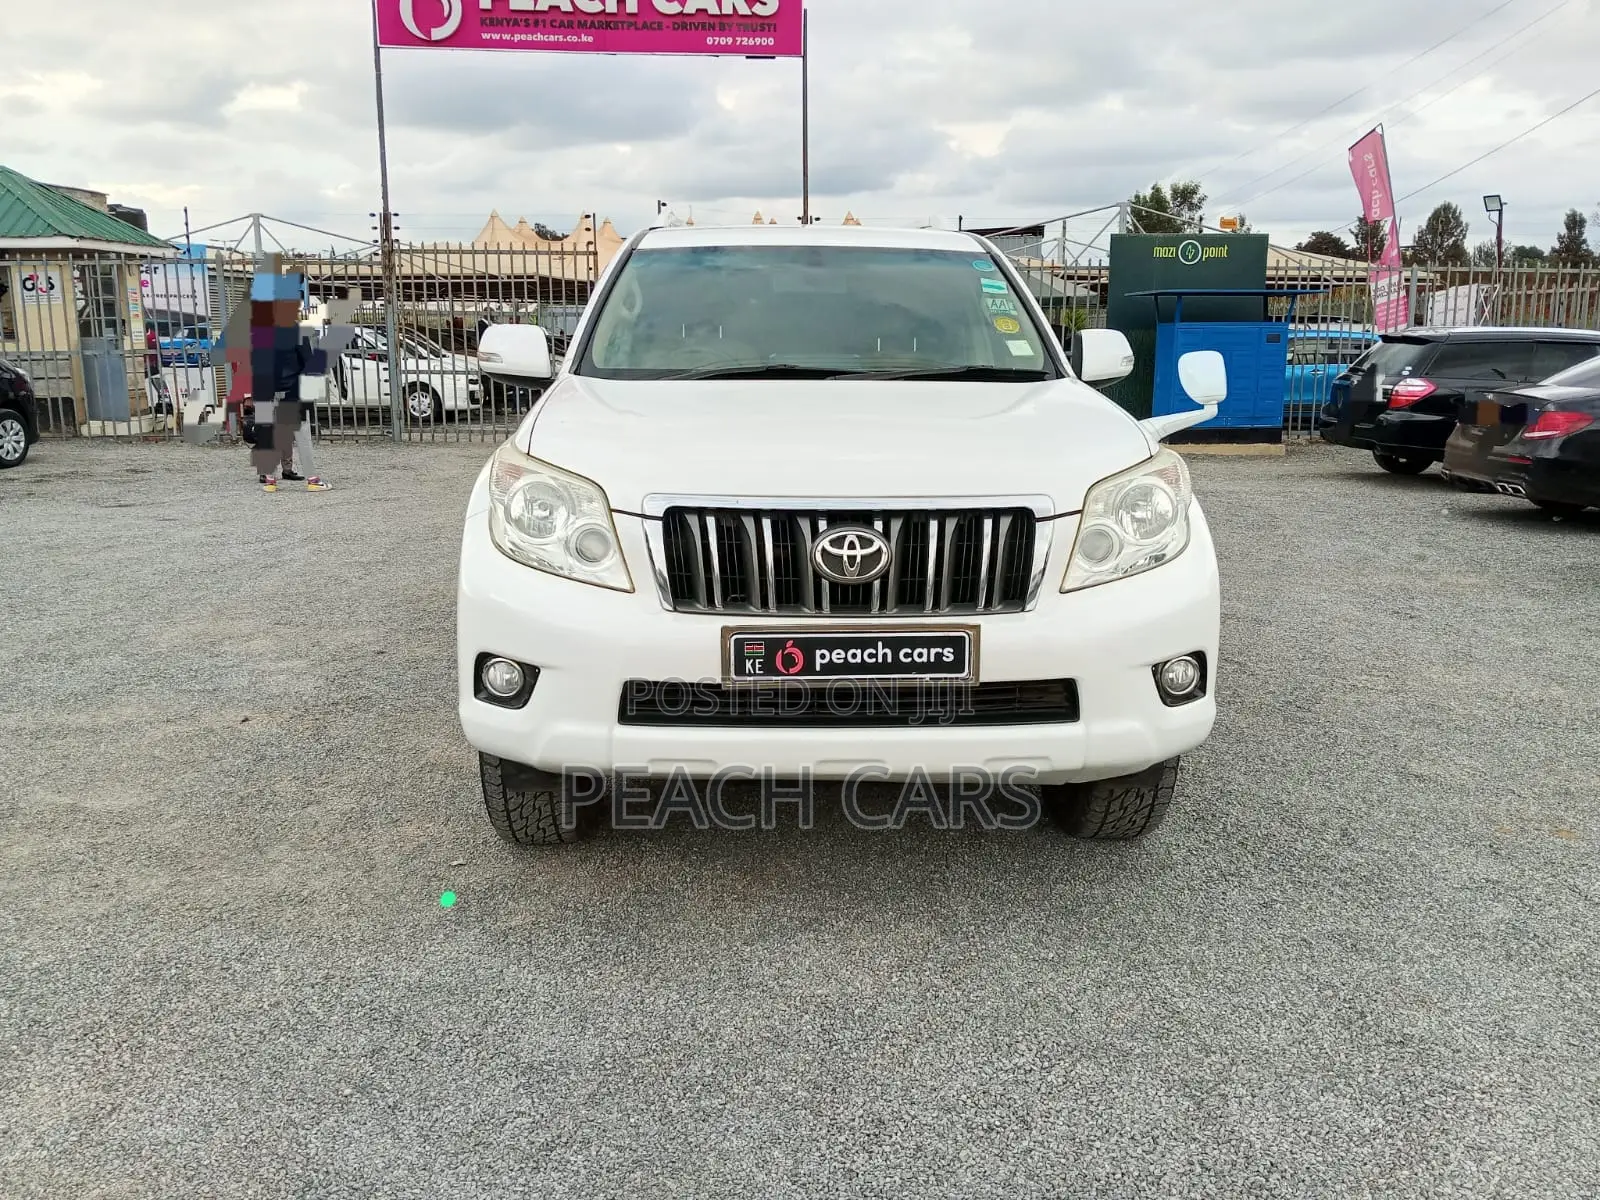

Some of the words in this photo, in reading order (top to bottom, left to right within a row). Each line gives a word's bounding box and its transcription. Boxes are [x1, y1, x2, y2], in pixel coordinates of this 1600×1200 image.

[480, 17, 530, 28] KENYA'S
[550, 19, 574, 29] CAR
[576, 19, 663, 31] MARKETPLACE
[671, 21, 716, 32] DRIVEN
[718, 22, 733, 32] BY
[481, 32, 594, 43] www.peachcars.co.ke
[706, 36, 733, 46] 0709
[735, 36, 775, 46] 726900
[1202, 244, 1228, 261] point
[815, 641, 893, 671] peach
[898, 646, 955, 664] cars
[745, 659, 764, 674] KE
